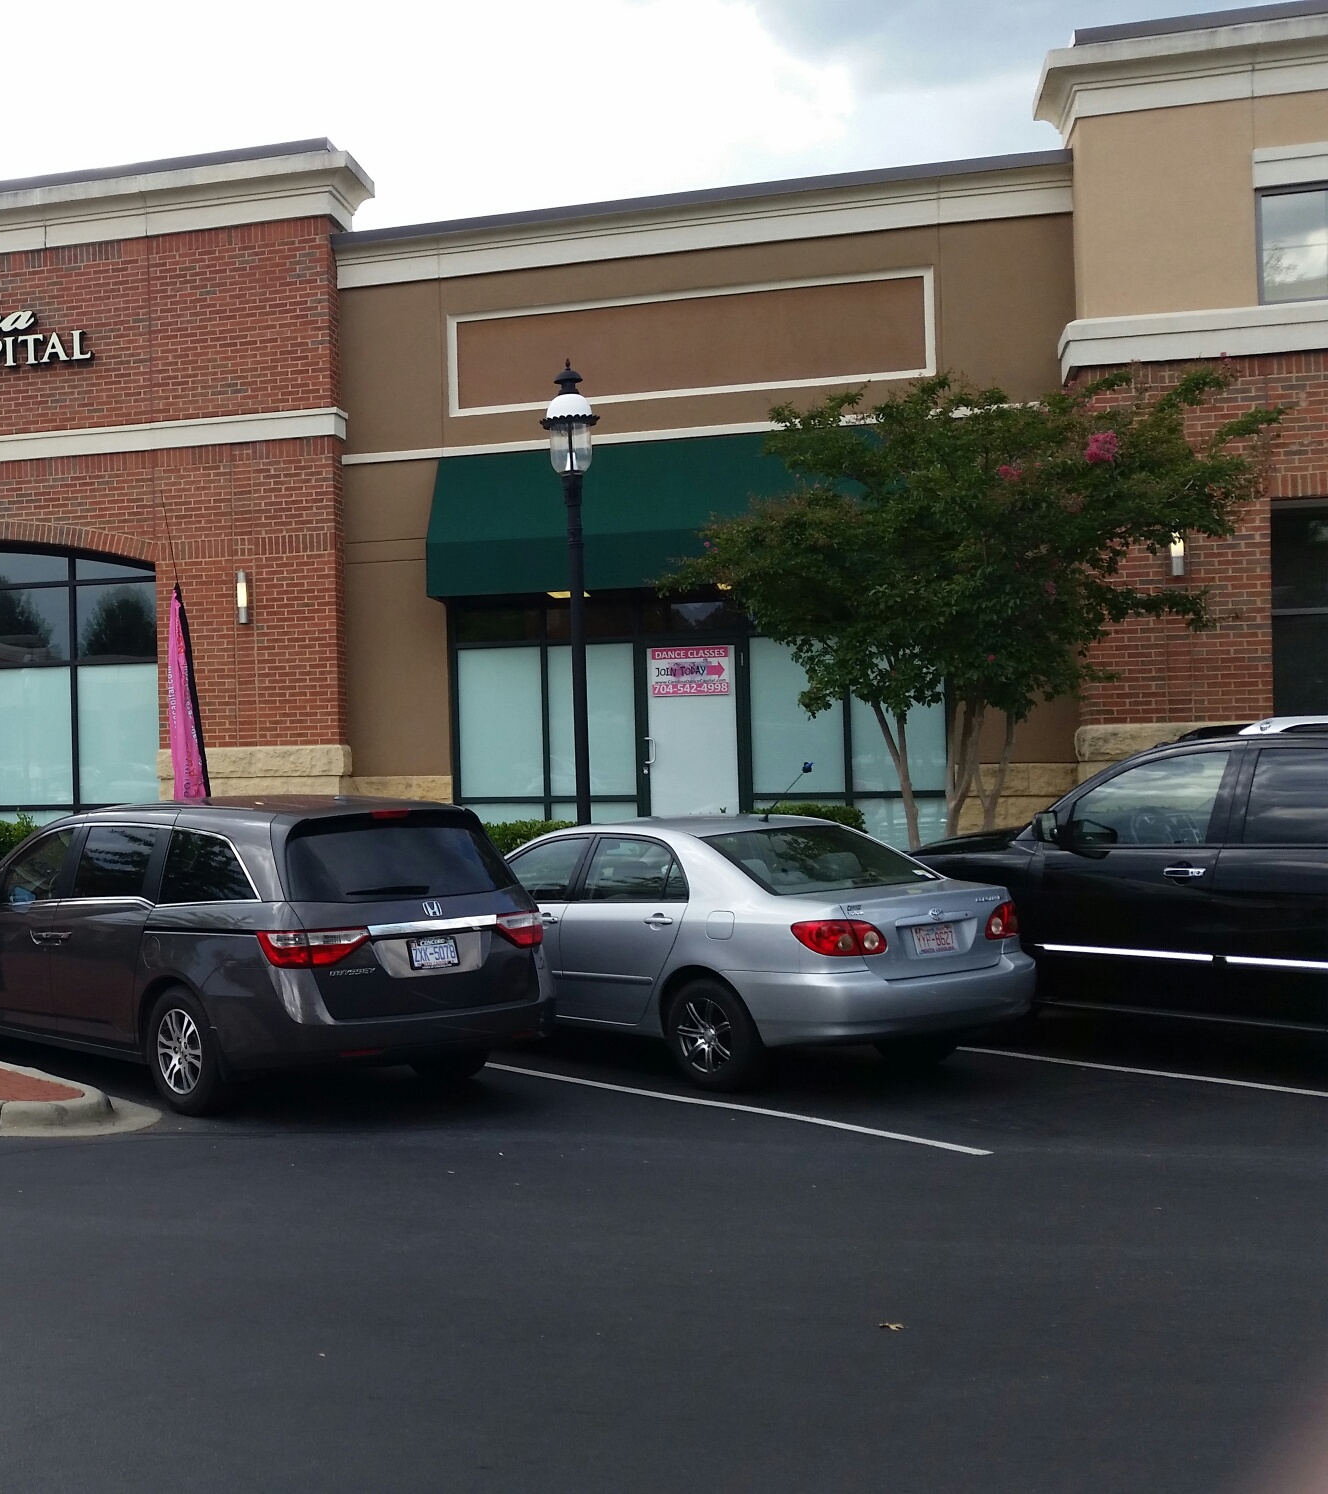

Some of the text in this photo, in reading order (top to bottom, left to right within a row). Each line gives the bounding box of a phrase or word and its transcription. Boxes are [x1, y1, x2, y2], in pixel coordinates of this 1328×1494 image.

[655, 648, 725, 659] DANCE CLASSES
[655, 665, 706, 677] JOIN TODAY
[653, 683, 728, 694] 704-542-4998
[412, 944, 457, 963] ZXK-5078
